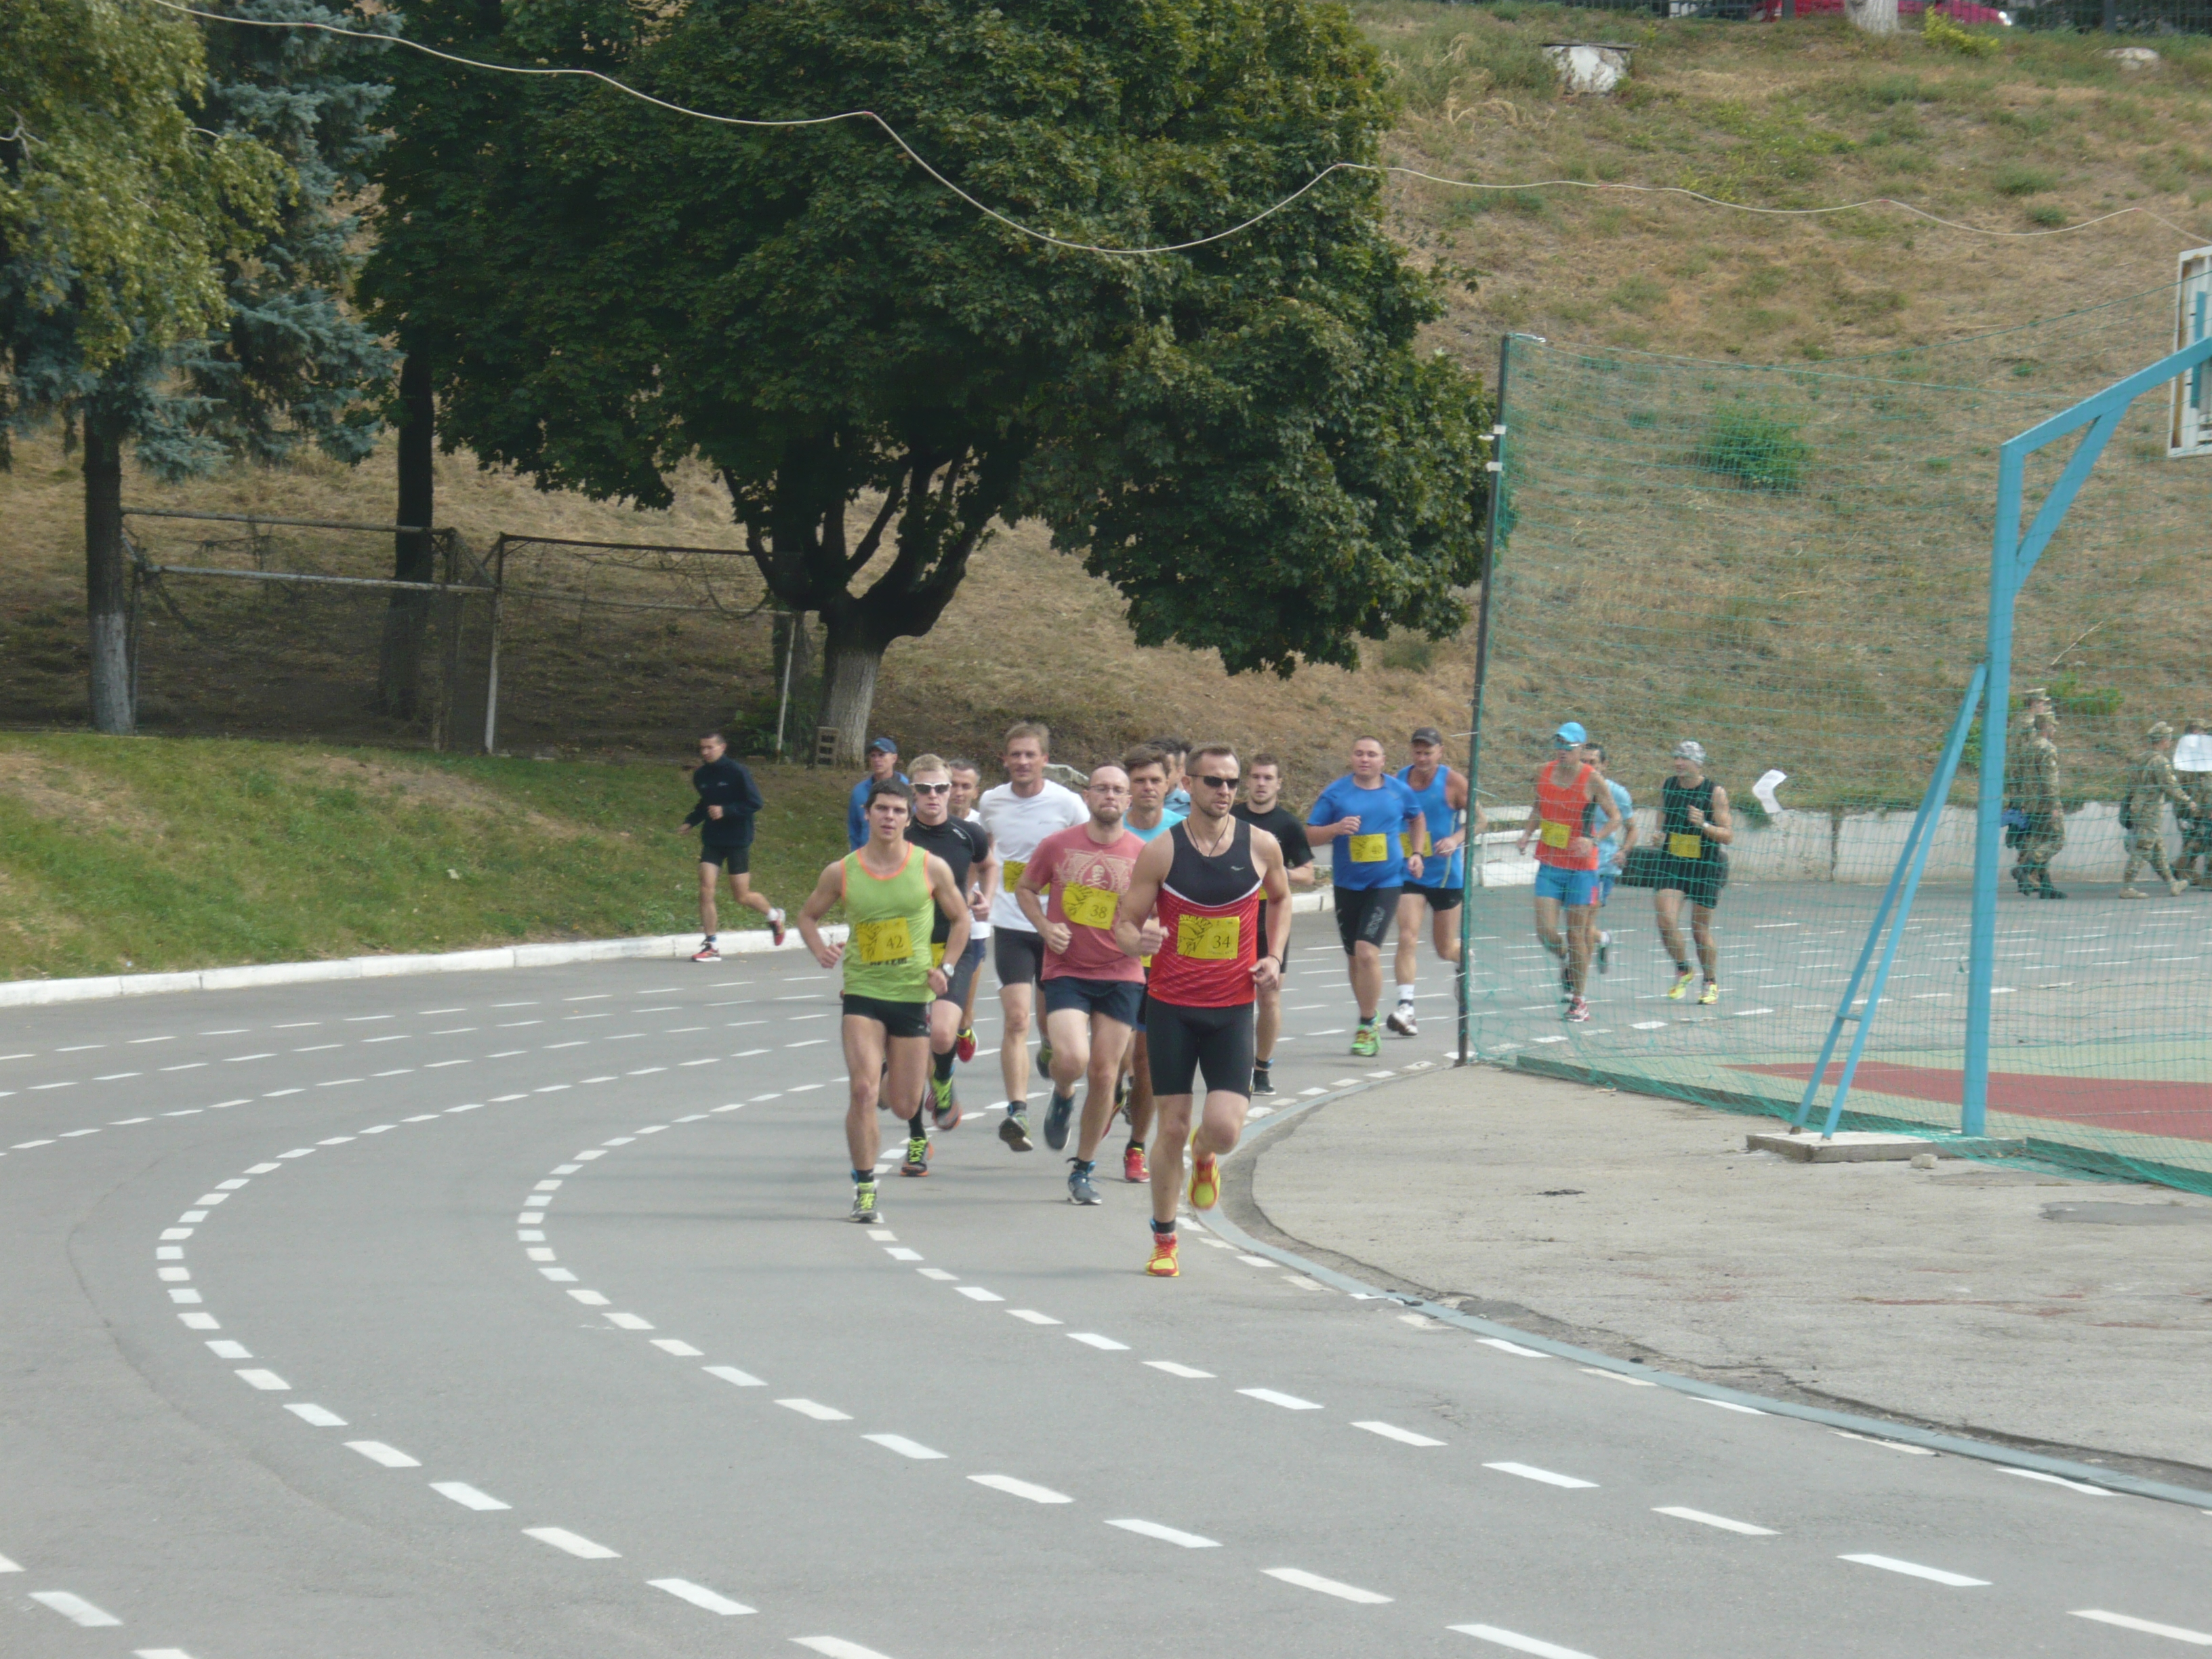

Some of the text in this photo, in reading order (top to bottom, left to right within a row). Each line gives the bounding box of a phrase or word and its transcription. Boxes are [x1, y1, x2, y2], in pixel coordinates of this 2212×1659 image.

[1090, 904, 1108, 919] 38
[886, 935, 904, 950] 42
[1212, 935, 1231, 949] 34
